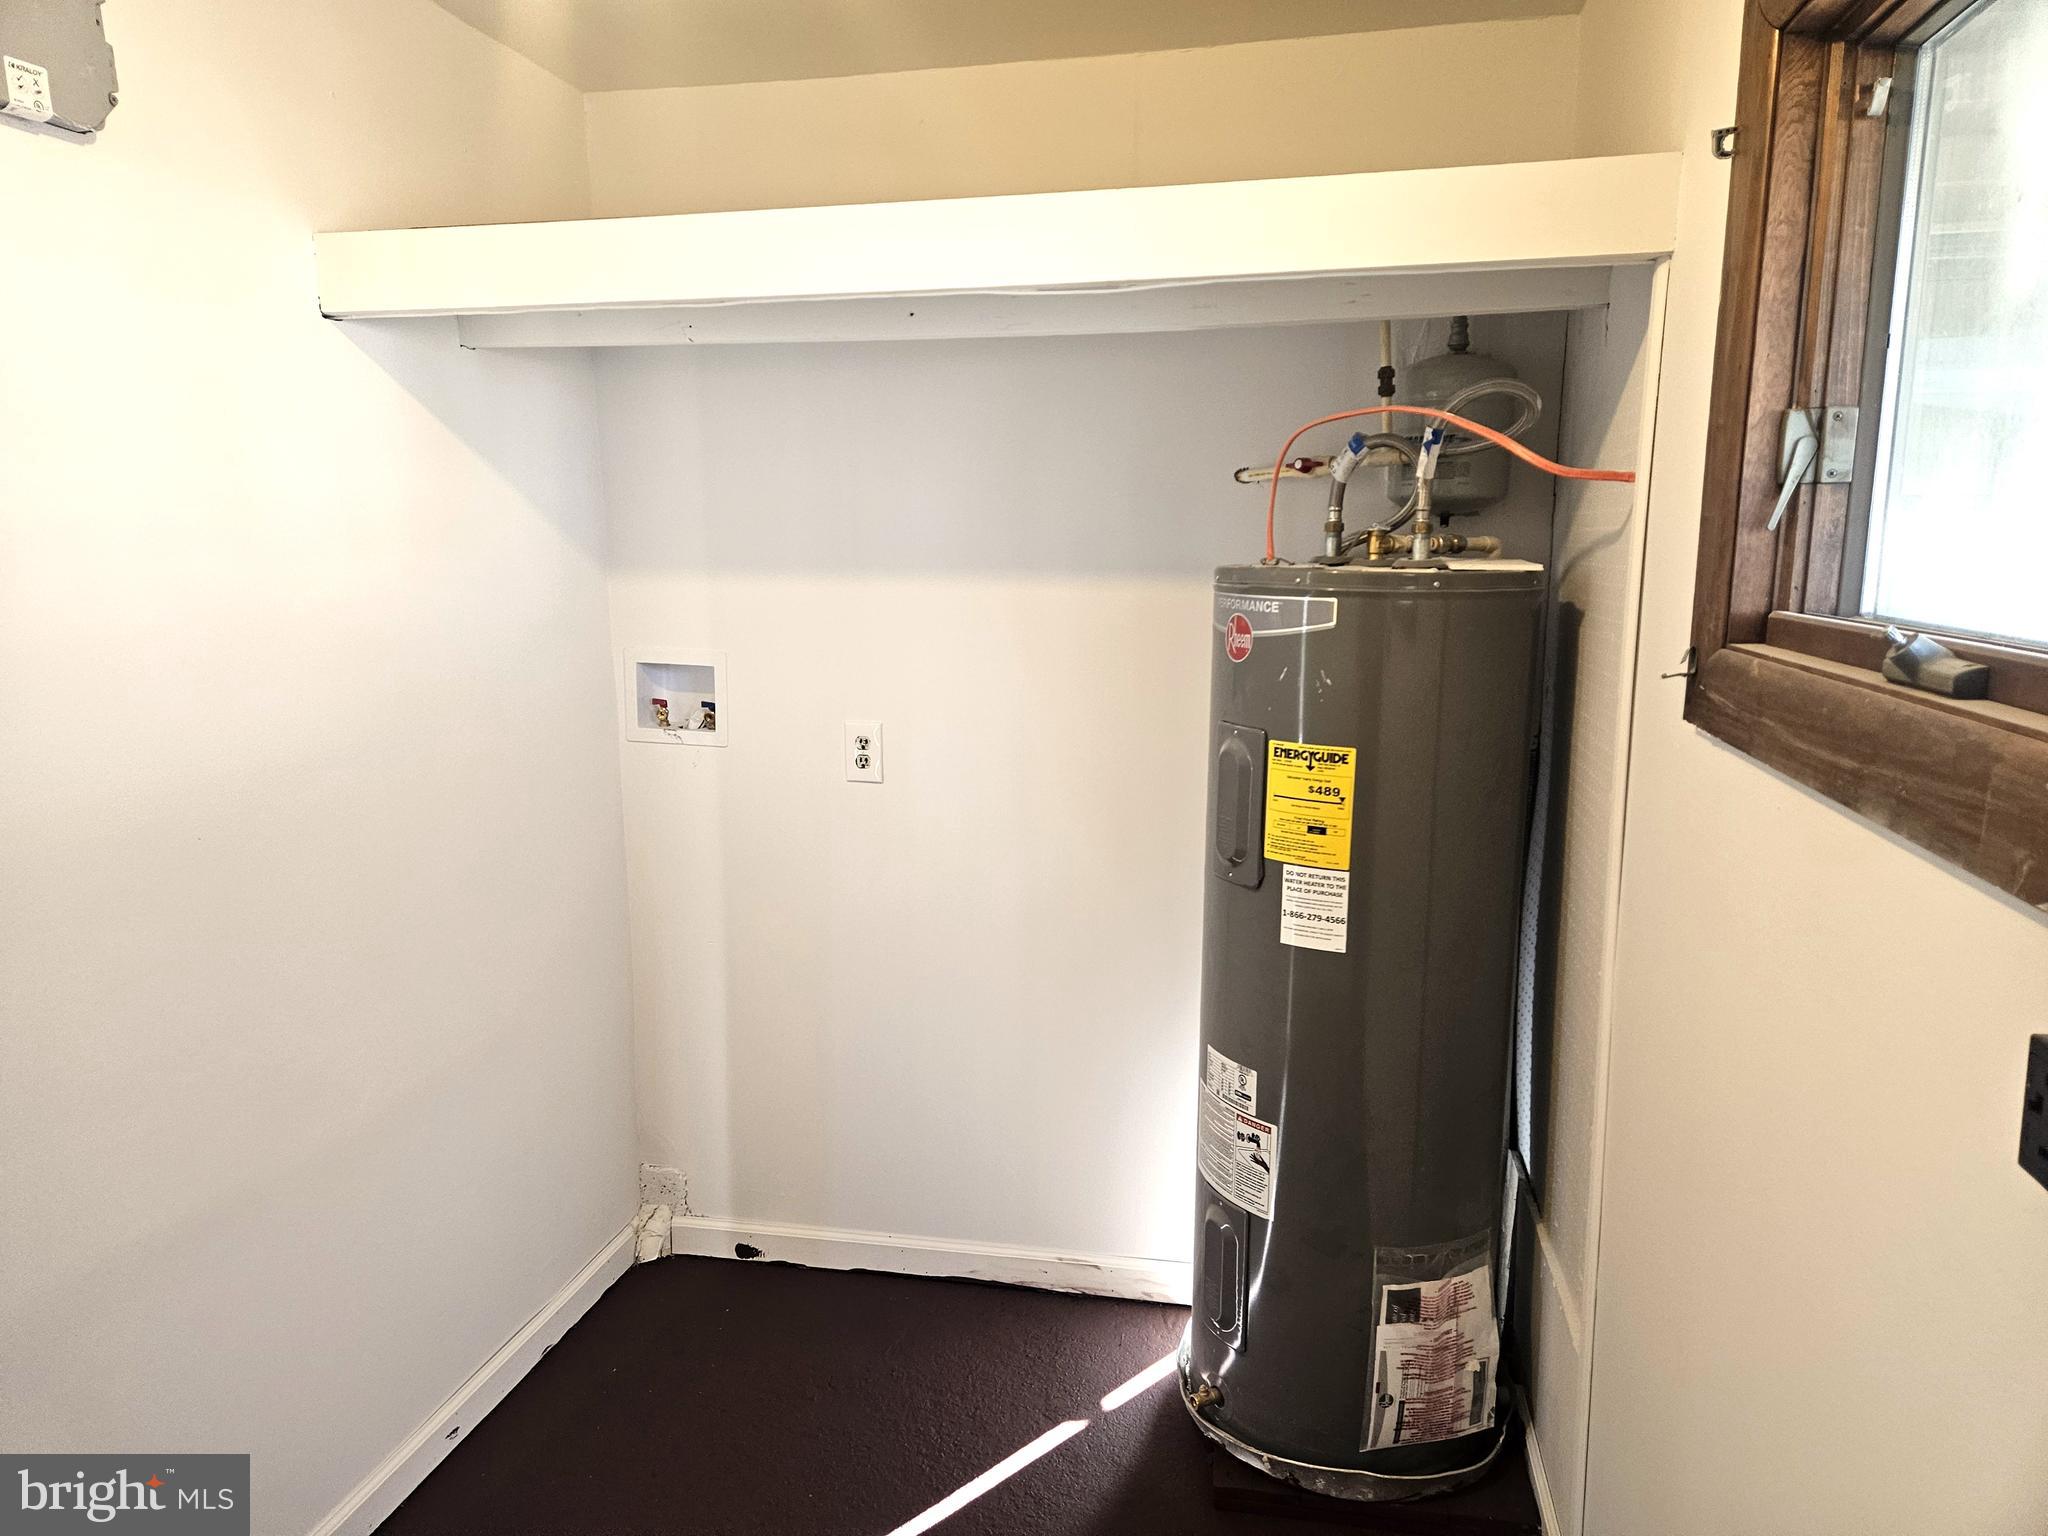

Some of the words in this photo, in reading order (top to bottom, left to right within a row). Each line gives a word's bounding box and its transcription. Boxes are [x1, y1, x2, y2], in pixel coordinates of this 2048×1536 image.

[1227, 615, 1252, 655] Rheem
[1308, 785, 1341, 797] $489
[1308, 873, 1331, 881] RETURN
[1283, 909, 1346, 924] 1-866-279-4566
[1242, 1116, 1270, 1133] DANGER
